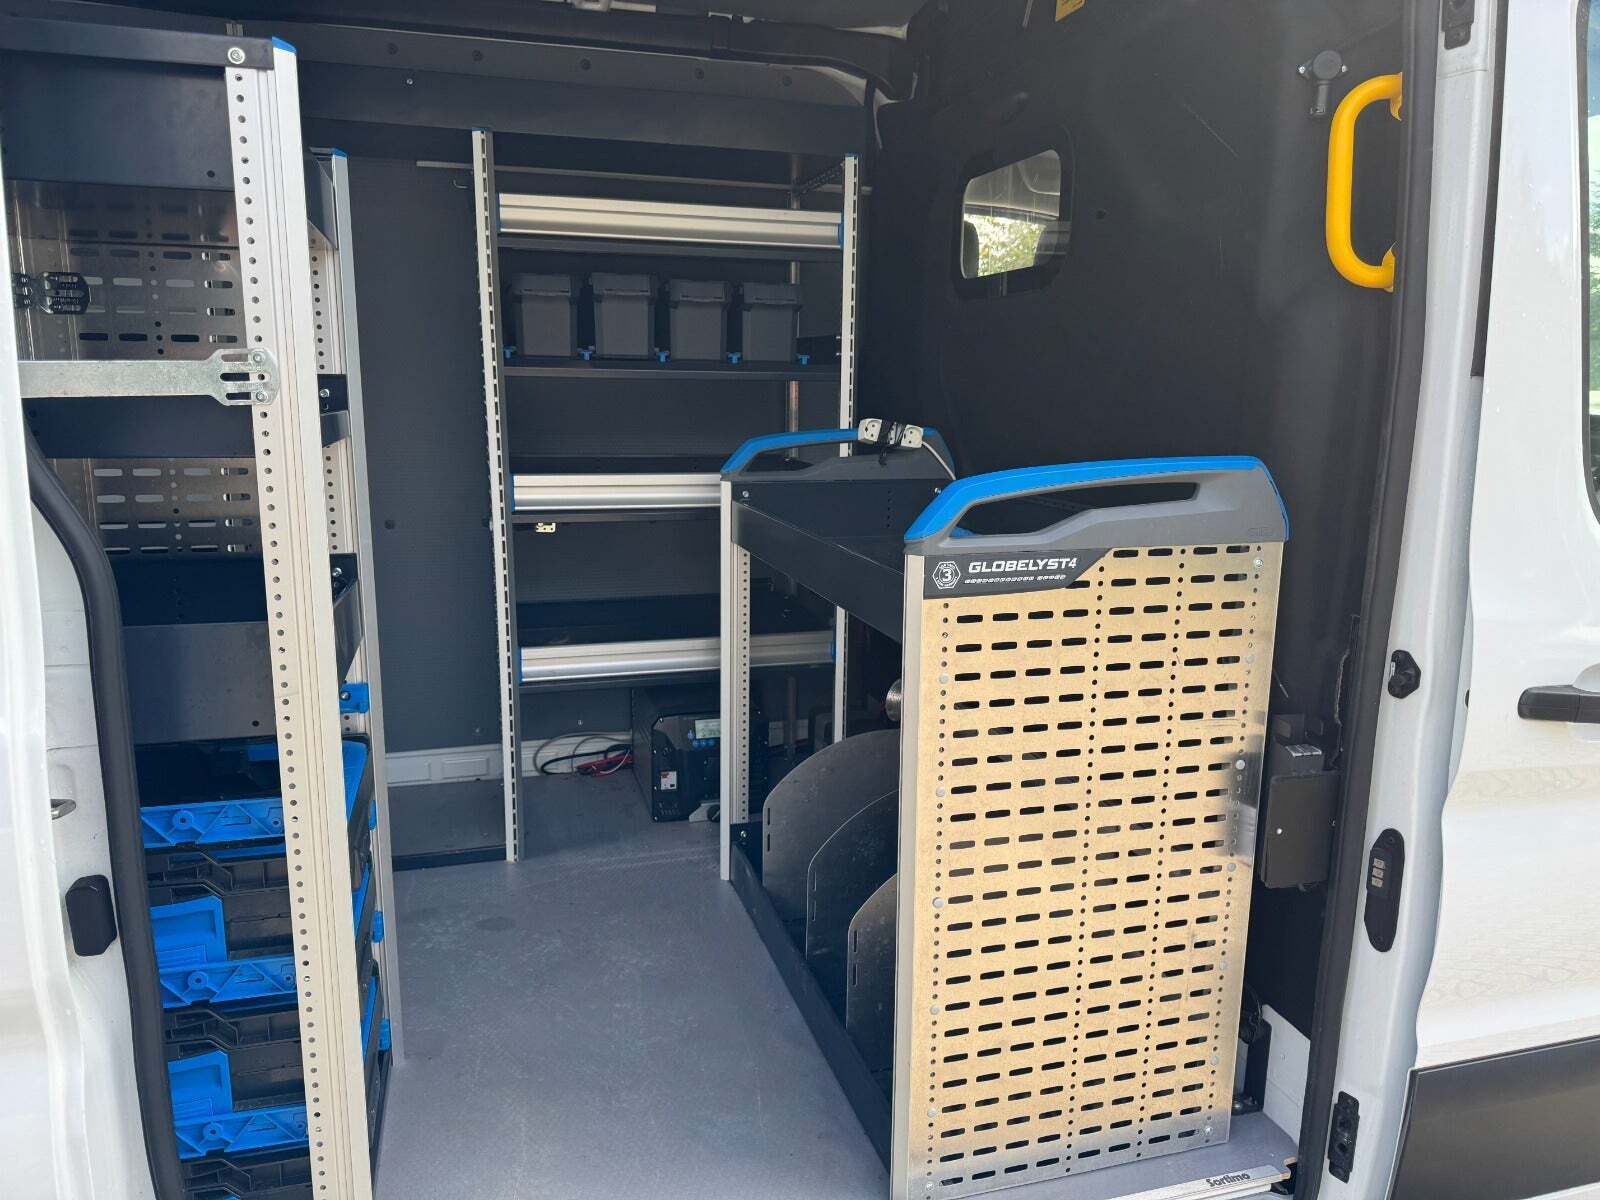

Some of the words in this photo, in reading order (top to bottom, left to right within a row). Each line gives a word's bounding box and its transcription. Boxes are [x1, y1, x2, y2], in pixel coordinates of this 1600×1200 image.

[968, 557, 1077, 574] GLOBELYST4
[942, 568, 952, 582] 3
[1205, 1172, 1251, 1188] Sortimo
